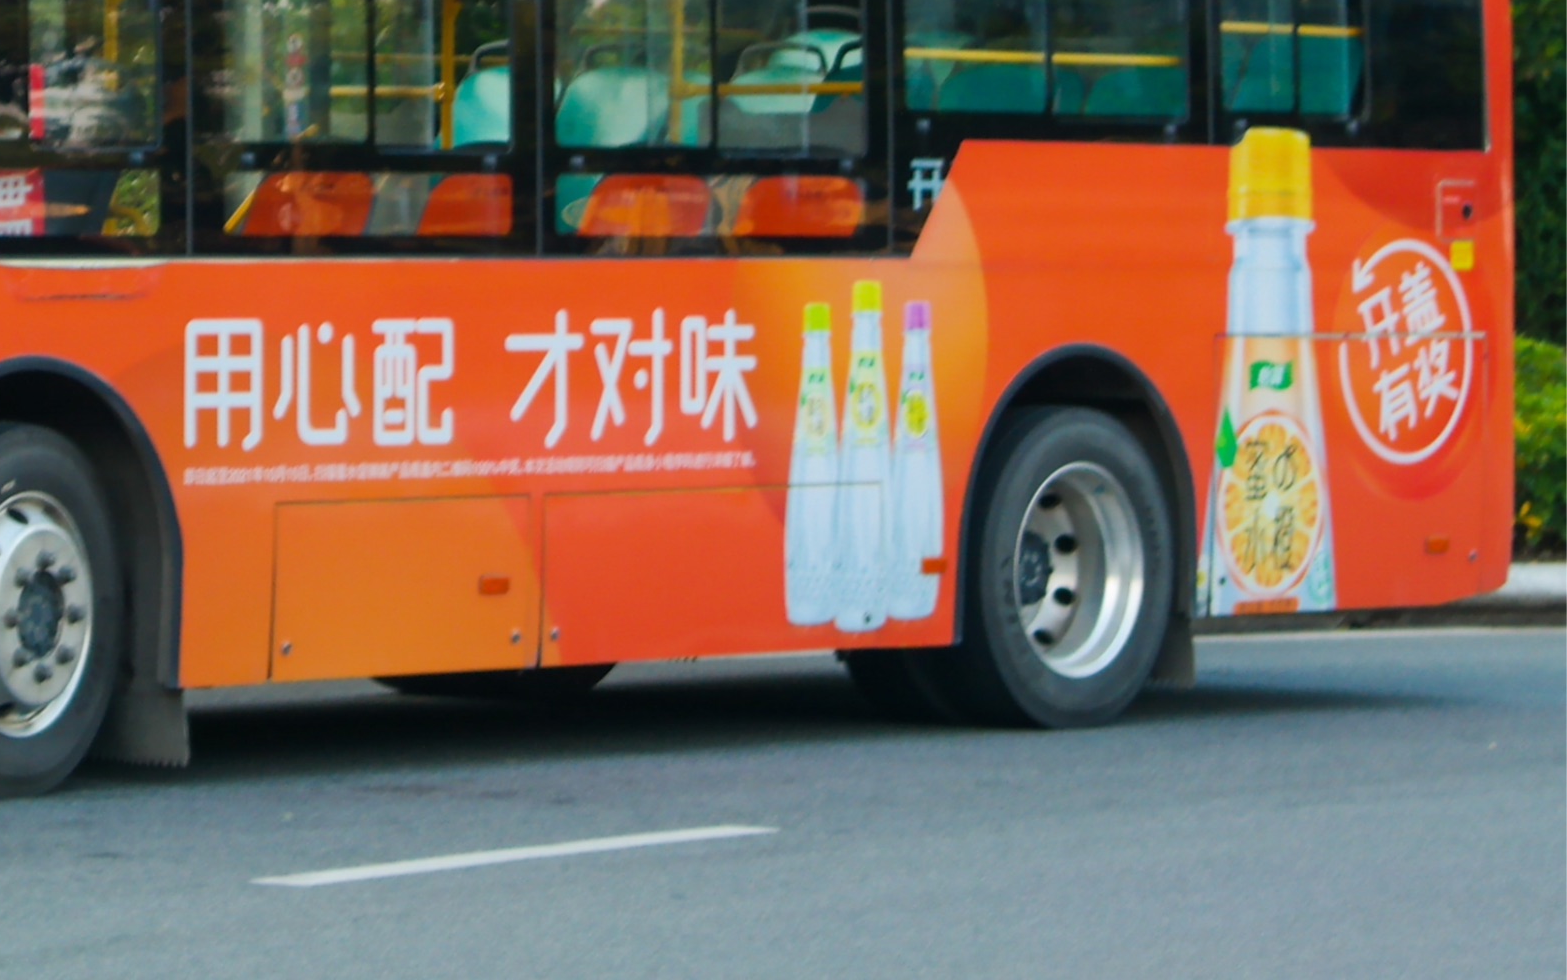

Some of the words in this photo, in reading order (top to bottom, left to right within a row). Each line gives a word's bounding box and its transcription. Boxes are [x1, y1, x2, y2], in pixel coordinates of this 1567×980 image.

[1357, 260, 1447, 370] 开盖
[184, 318, 454, 451] 用心配
[503, 307, 758, 449] 才对味
[1371, 337, 1461, 443] 有奖
